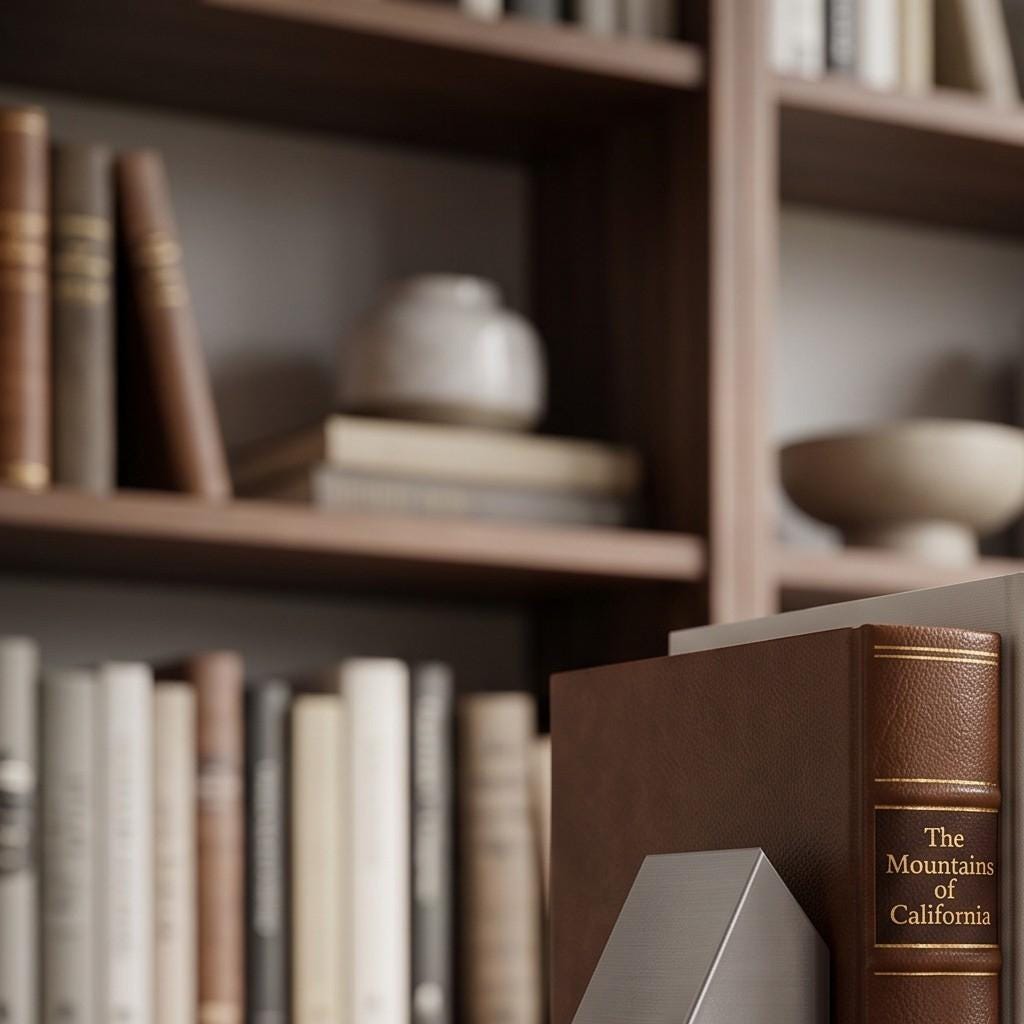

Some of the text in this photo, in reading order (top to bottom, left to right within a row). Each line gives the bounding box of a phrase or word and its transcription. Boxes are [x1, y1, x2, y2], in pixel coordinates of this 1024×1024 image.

[924, 826, 964, 848] The
[885, 853, 995, 876] Mountains
[934, 878, 957, 899] of
[890, 903, 991, 925] California
